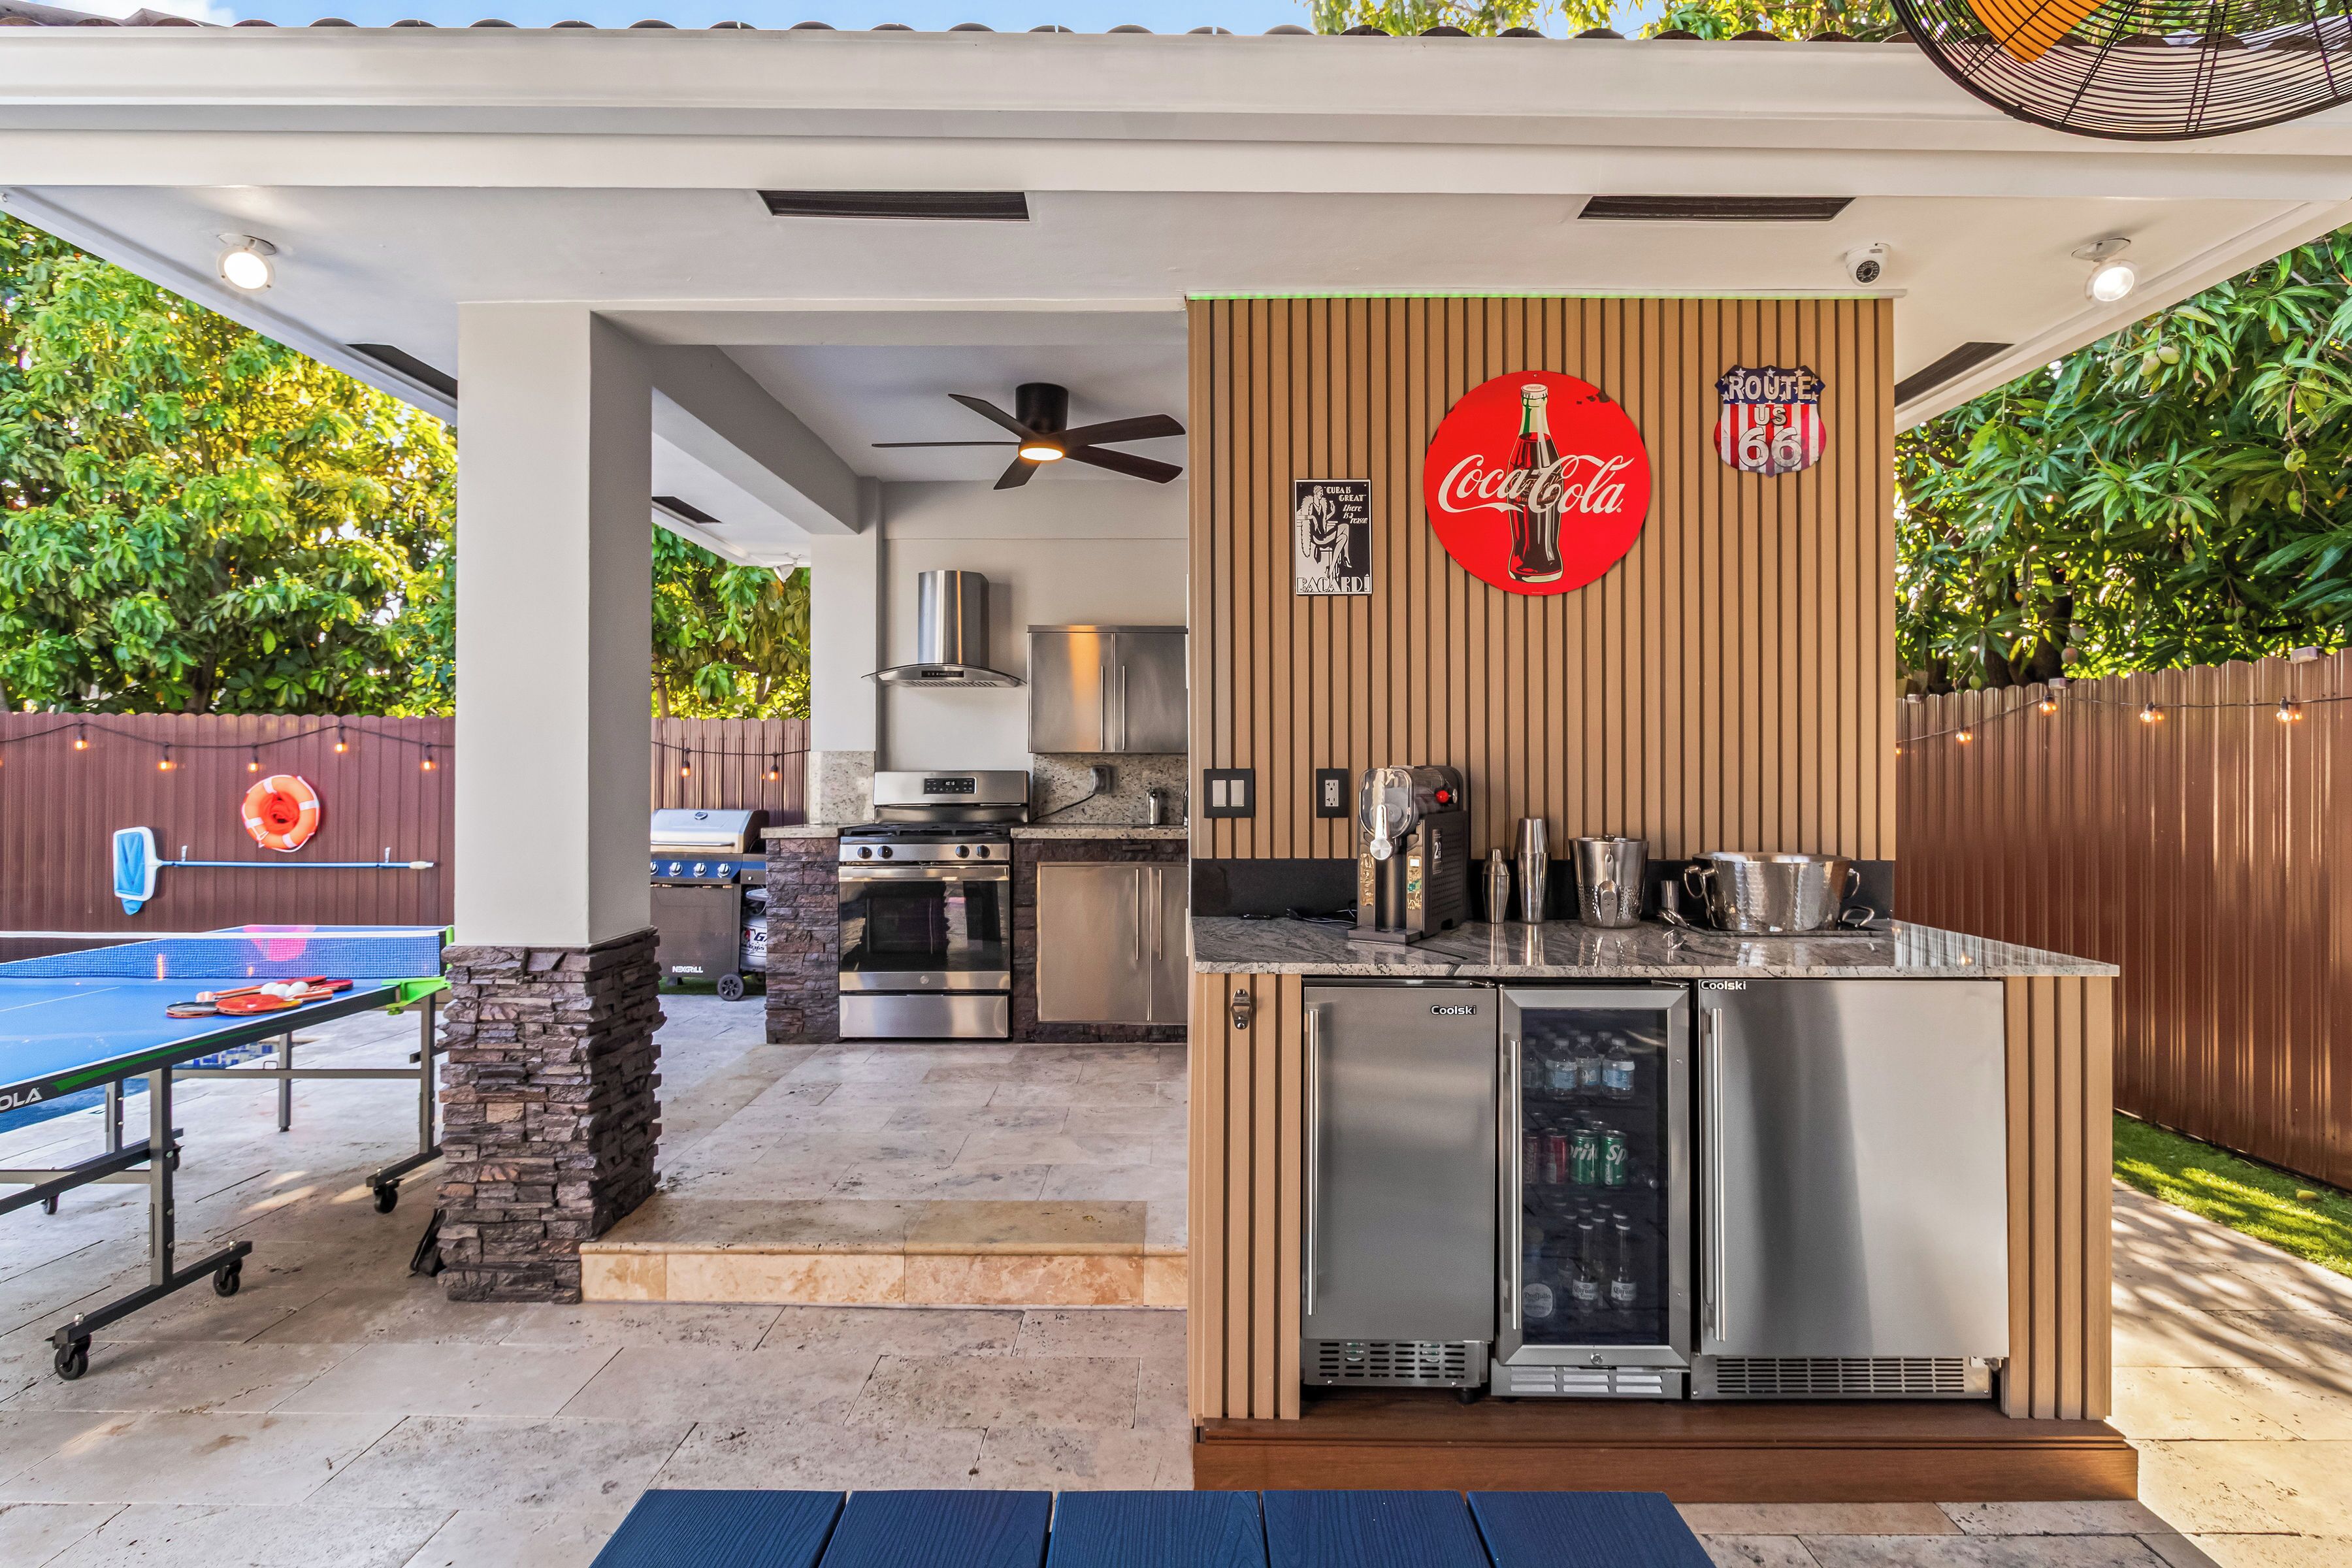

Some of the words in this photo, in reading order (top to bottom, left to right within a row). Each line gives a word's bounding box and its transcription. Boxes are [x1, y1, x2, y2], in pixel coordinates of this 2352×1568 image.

[1729, 376, 1812, 400] ROUTE
[1754, 407, 1787, 425] US
[1738, 427, 1802, 467] 66
[1438, 454, 1635, 514] Coca-Cola
[1701, 980, 1746, 990] Coolski
[1431, 1005, 1477, 1015] Coolski
